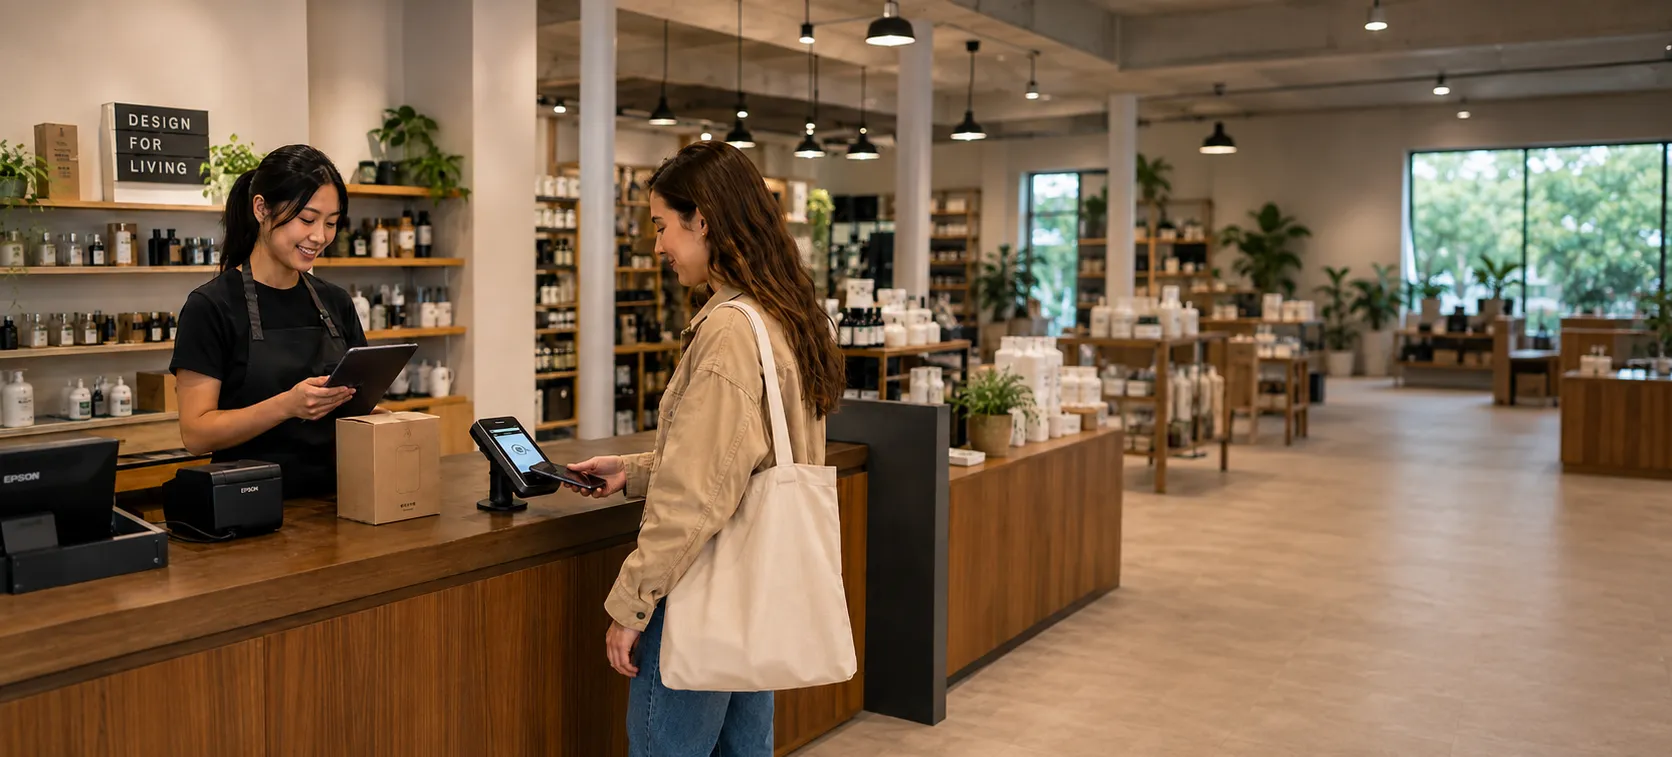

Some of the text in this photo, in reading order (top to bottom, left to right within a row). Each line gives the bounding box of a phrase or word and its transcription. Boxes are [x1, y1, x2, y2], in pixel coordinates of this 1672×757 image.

[129, 114, 190, 130] DESIGN
[130, 137, 161, 150] FOR
[130, 160, 187, 174] LIVING
[4, 472, 40, 483] EPSON
